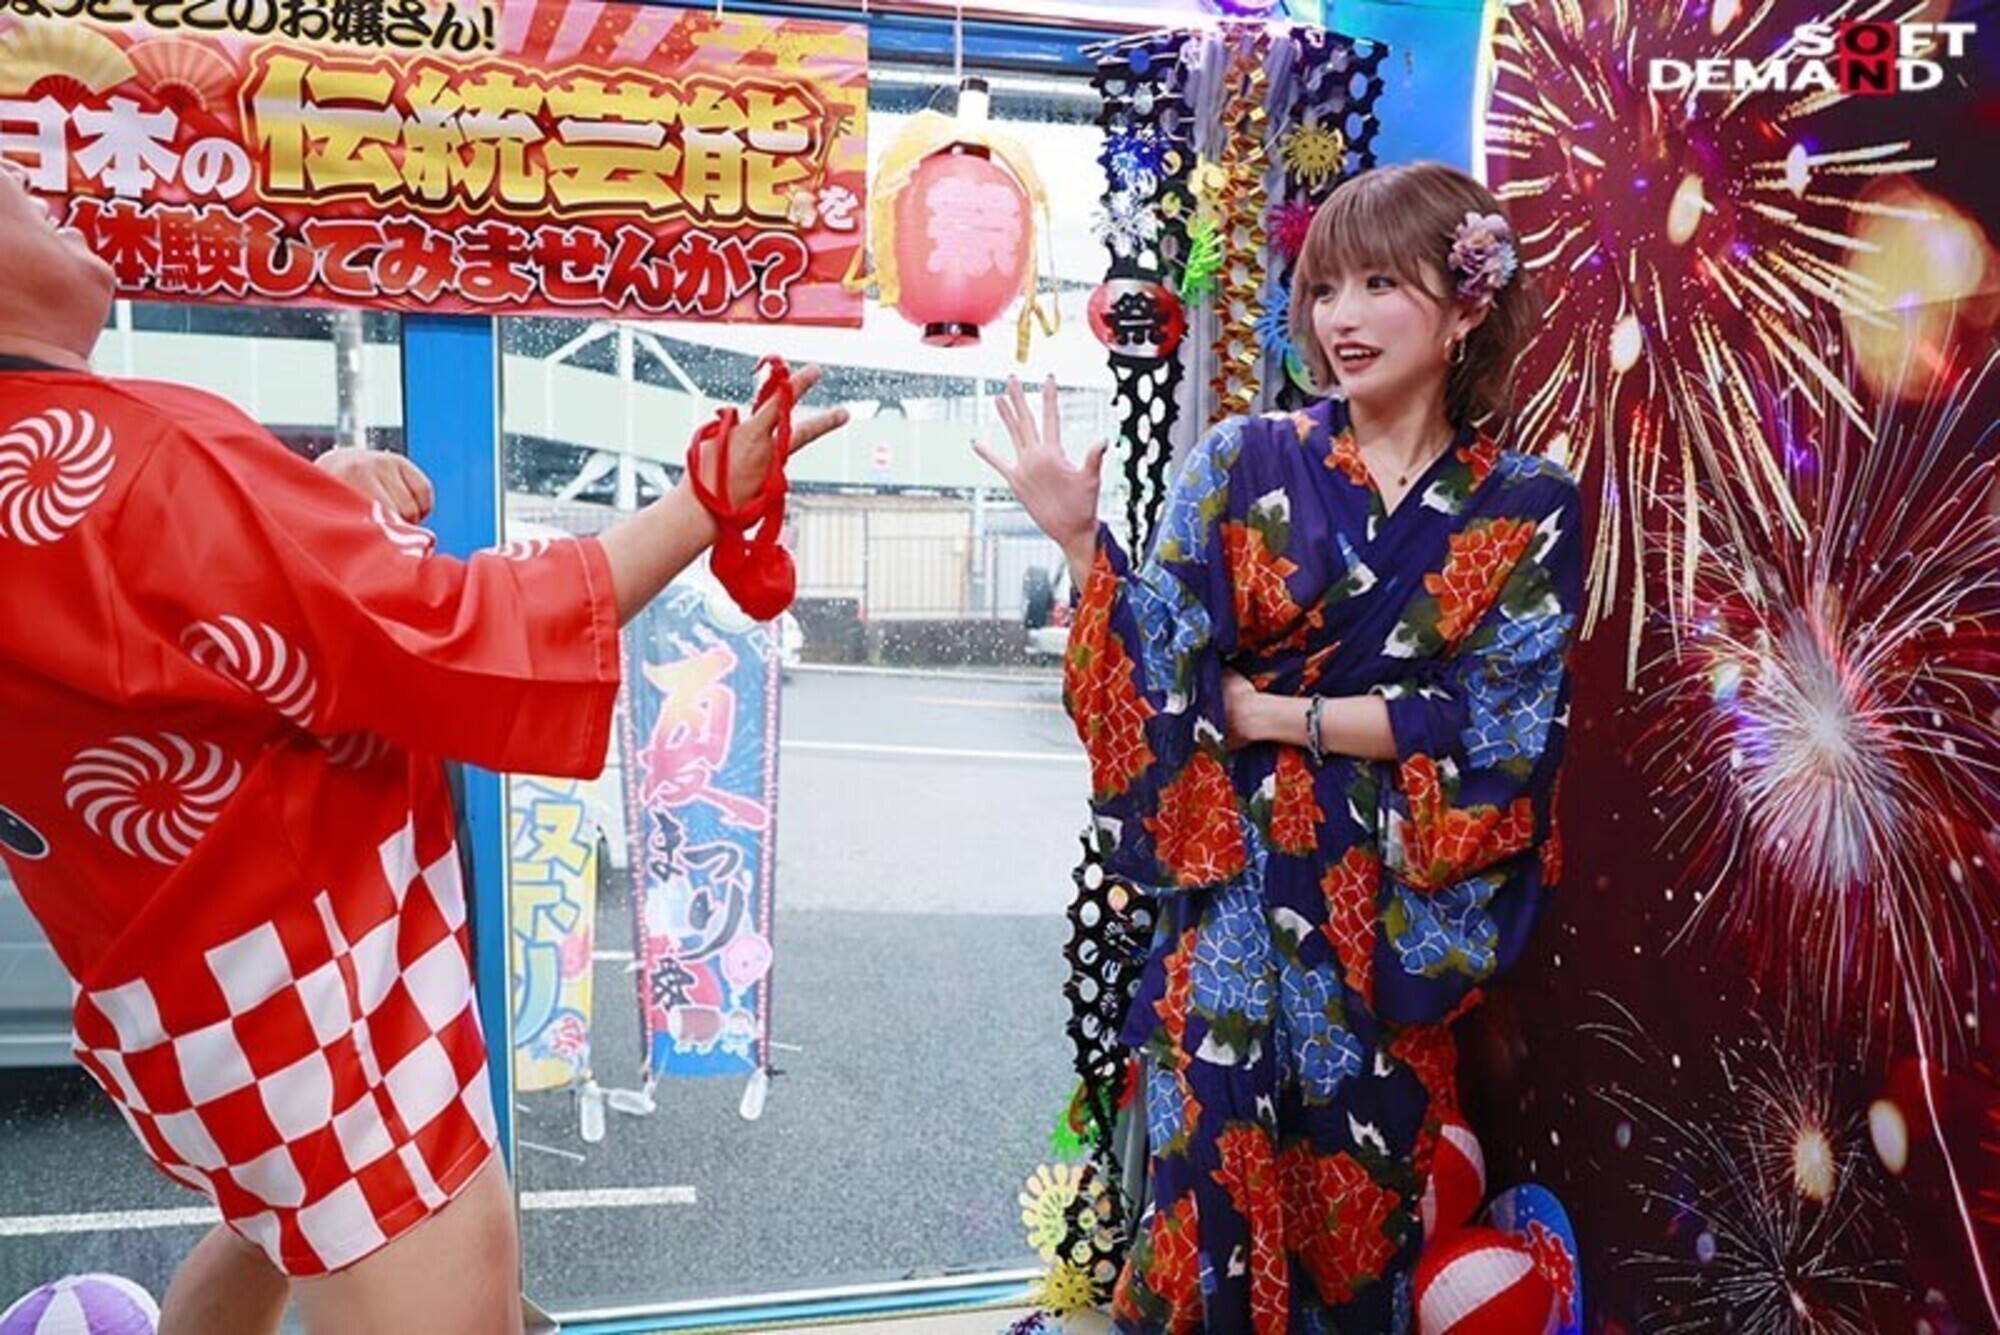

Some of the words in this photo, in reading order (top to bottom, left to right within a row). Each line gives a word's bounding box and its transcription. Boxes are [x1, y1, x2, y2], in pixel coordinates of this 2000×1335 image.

[0, 0, 495, 50] ょっとそこのお嬢さん!
[0, 55, 858, 230] 日本の伝統芸能を
[64, 197, 808, 319] 体験してみませんか?
[637, 640, 770, 962] 夏まつり
